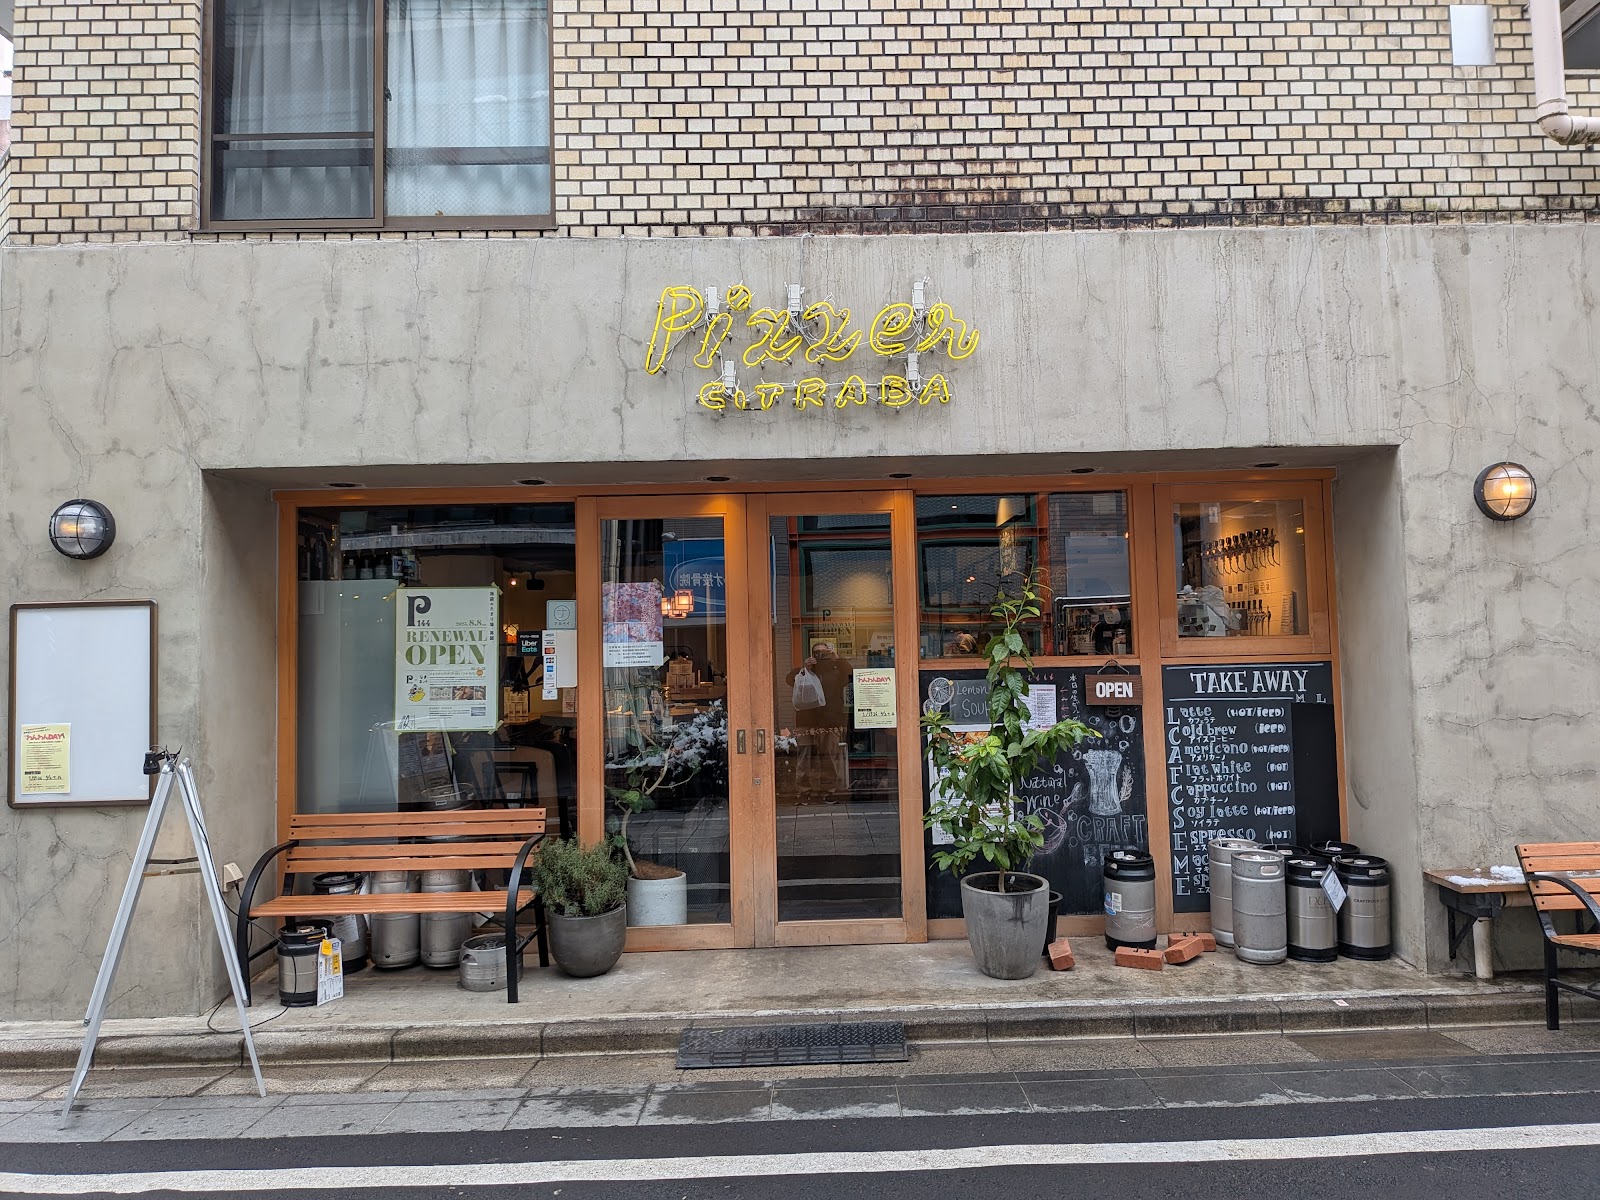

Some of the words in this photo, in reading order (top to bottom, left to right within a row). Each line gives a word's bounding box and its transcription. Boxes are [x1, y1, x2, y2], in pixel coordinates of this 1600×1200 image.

[407, 595, 432, 627] P
[406, 630, 488, 643] RENEWAL
[405, 644, 488, 665] OPEN
[956, 682, 989, 695] Lemon
[1190, 670, 1248, 694] TAKE
[1252, 670, 1308, 692] AWAY
[1095, 681, 1133, 698] OPEN
[1295, 694, 1305, 703] M
[1316, 694, 1326, 703] L
[1187, 717, 1216, 725] カフェラテ
[1207, 724, 1237, 736] brew
[1188, 735, 1235, 744] アイスコーヒー
[1190, 753, 1226, 763] アメリカーノ
[1019, 770, 1067, 790] Natural
[1190, 773, 1241, 783] フラットホワイト
[1193, 796, 1229, 804] カプチーノ
[1210, 805, 1249, 818] latte
[1077, 815, 1145, 843] CRAFT
[1191, 819, 1220, 828] ソイラテ
